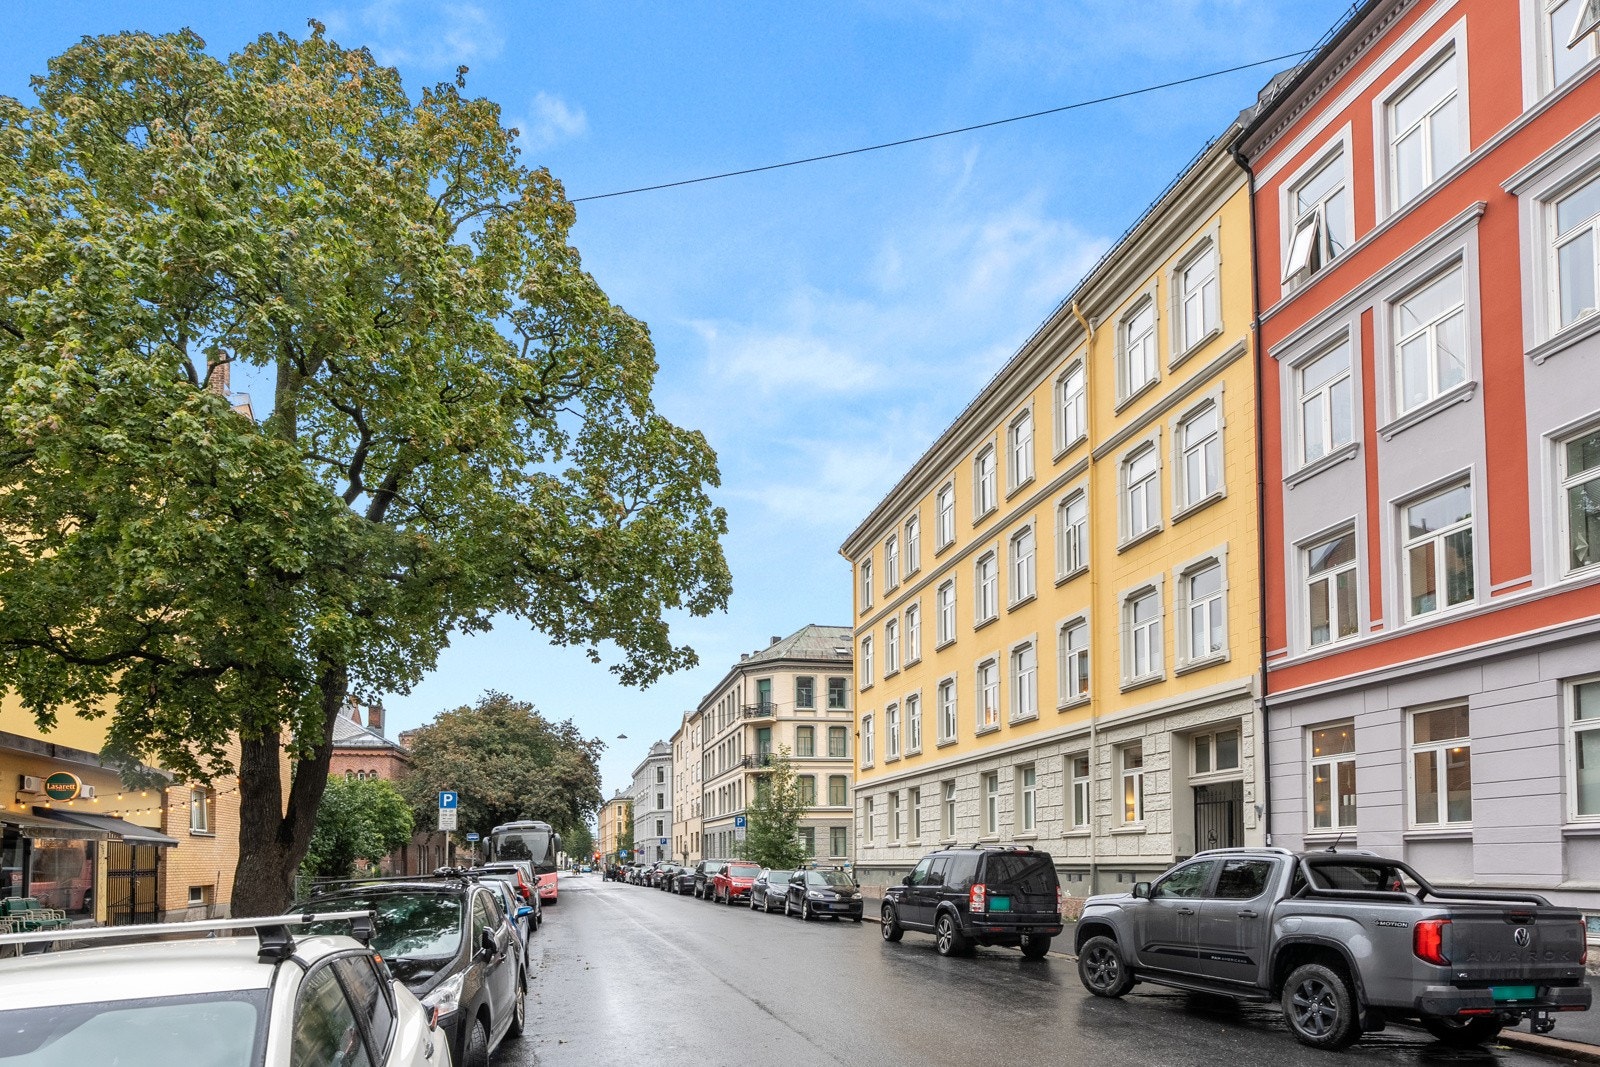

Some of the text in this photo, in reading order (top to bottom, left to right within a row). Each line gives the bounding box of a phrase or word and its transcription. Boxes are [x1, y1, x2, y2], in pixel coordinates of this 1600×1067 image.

[443, 794, 453, 807] P
[737, 818, 743, 826] P
[1466, 951, 1570, 962] AMAROK
